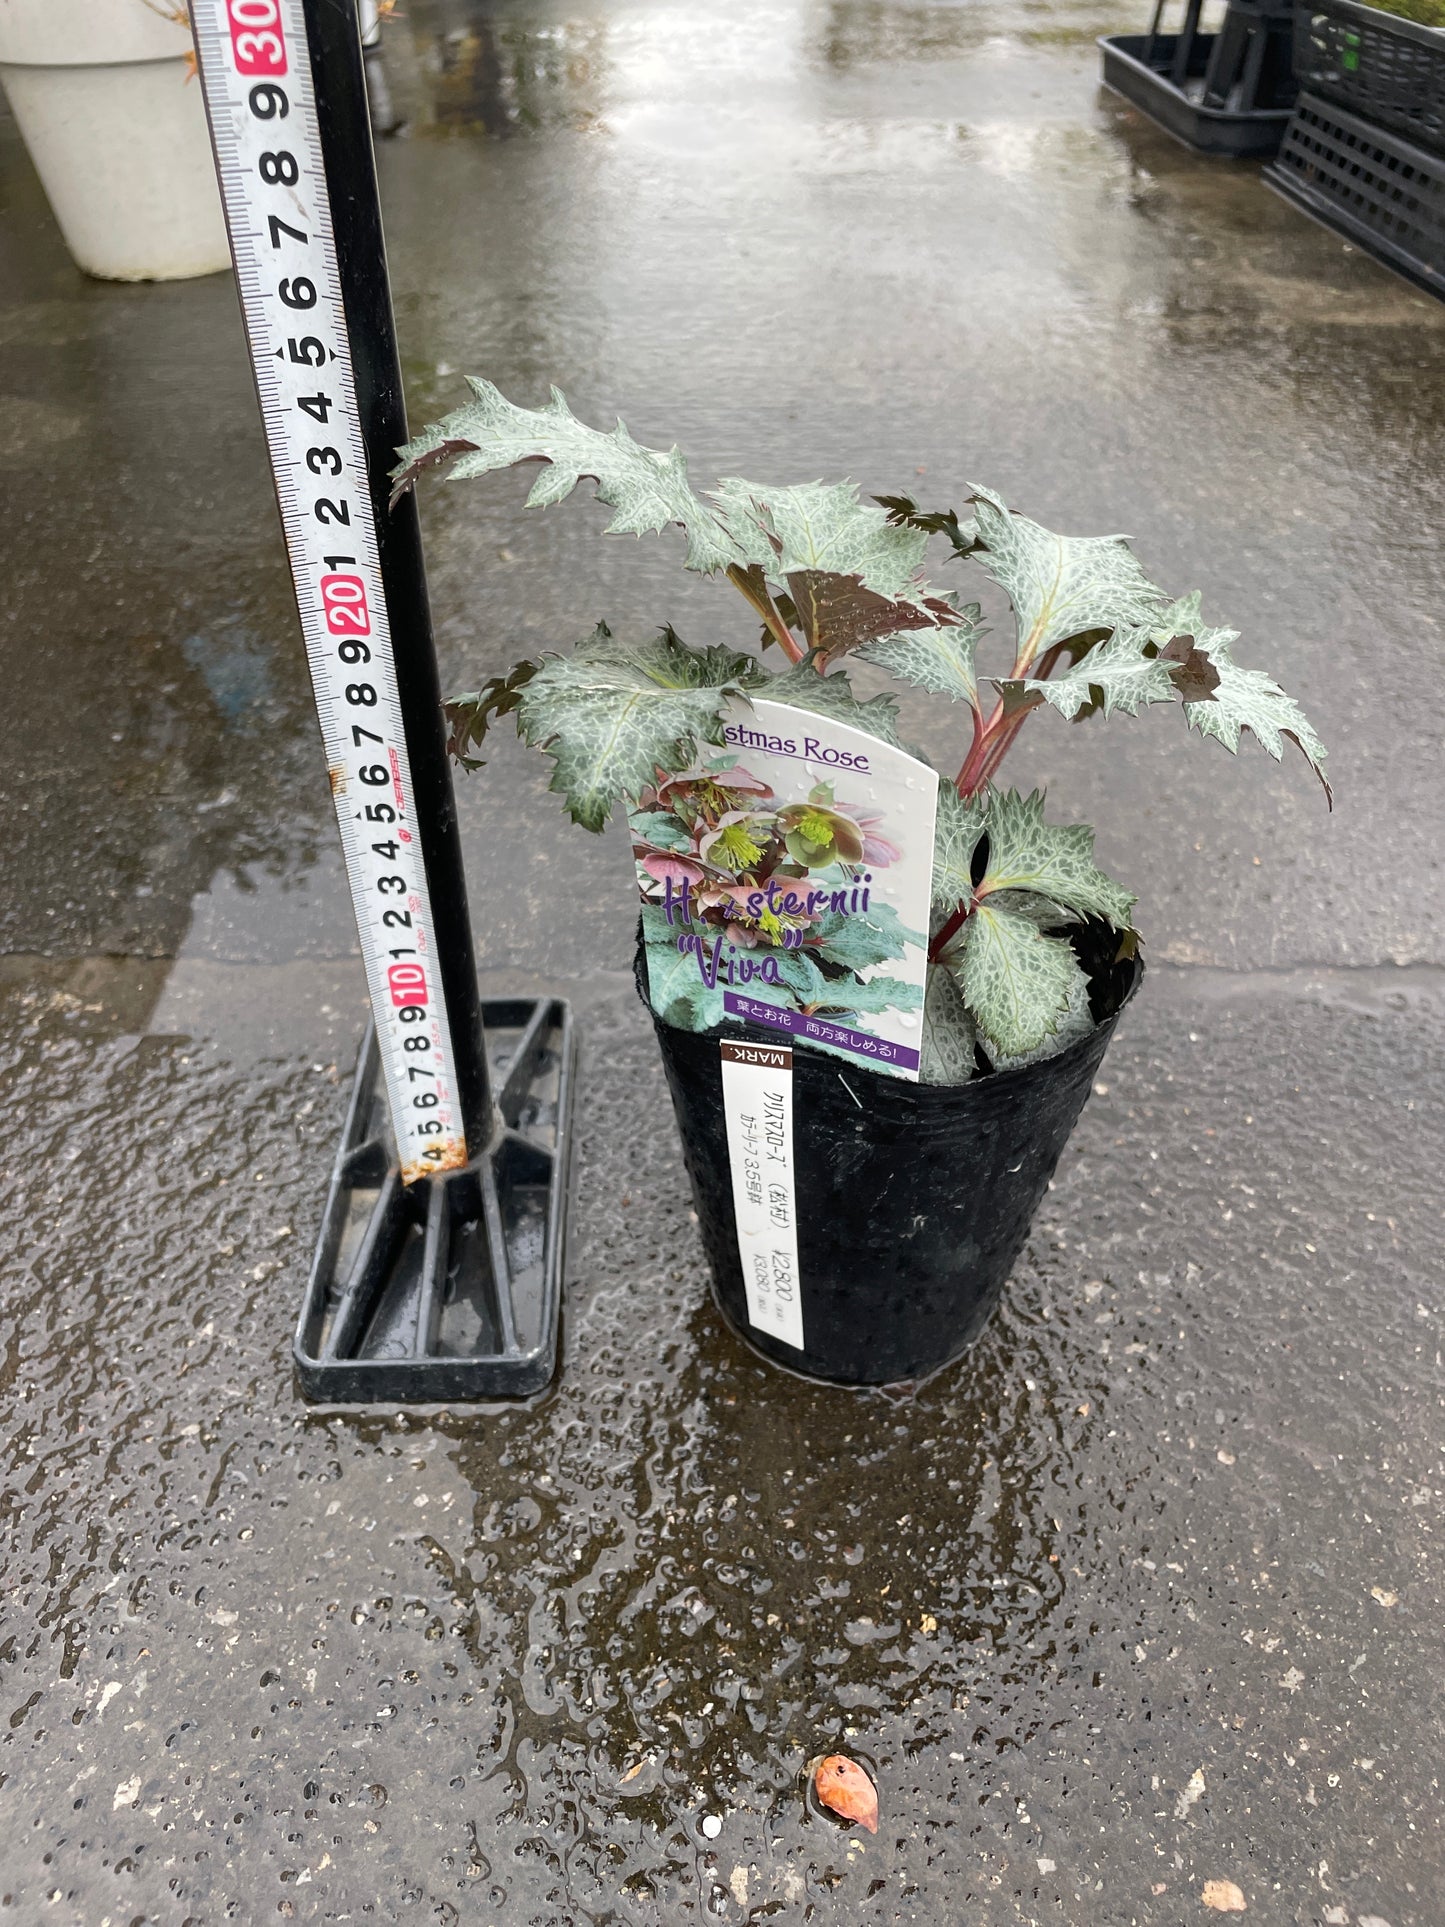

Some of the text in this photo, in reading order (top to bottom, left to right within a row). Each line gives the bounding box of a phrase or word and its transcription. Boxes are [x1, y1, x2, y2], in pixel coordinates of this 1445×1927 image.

[231, 0, 283, 64] 30
[249, 84, 289, 120] 9
[259, 151, 299, 187] 8
[268, 215, 308, 249] 7
[279, 276, 317, 310] 6
[287, 336, 326, 368] 5
[298, 392, 332, 424] 4
[306, 447, 342, 476] 3
[315, 498, 350, 526] 2
[324, 556, 356, 571] 1
[325, 581, 368, 628] 20
[338, 639, 371, 664] 9
[345, 683, 377, 707] 8
[352, 725, 383, 747] 7
[725, 724, 869, 770] stmas Rose
[359, 764, 390, 786] 6
[366, 803, 396, 823] 5
[371, 840, 400, 860] 4
[377, 876, 407, 894] 3
[662, 875, 708, 926] H.
[383, 910, 412, 928] 2
[389, 948, 416, 960] 1
[392, 968, 425, 1001] 10
[400, 1006, 426, 1023] 9
[736, 999, 897, 1058] 葉とお花 両方楽しめる!
[404, 1036, 430, 1052] 8
[730, 1048, 784, 1066] MARK.
[408, 1066, 435, 1082] 7
[413, 1092, 439, 1108] 6
[417, 1120, 443, 1136] 5
